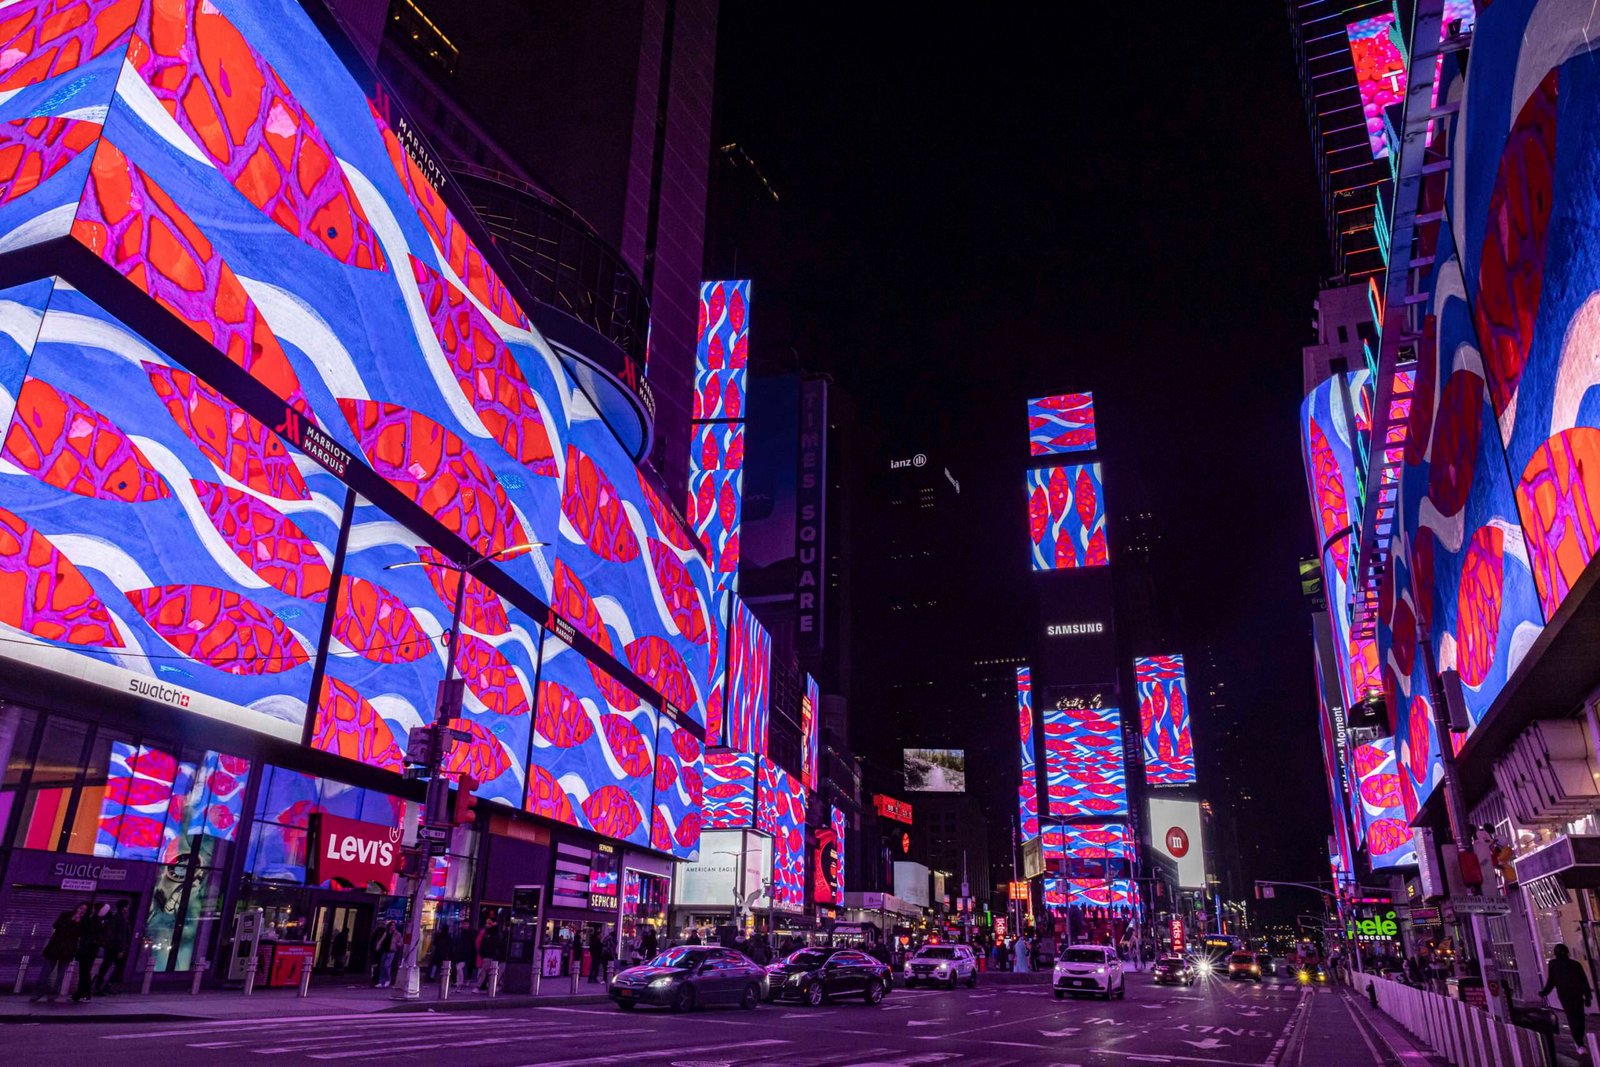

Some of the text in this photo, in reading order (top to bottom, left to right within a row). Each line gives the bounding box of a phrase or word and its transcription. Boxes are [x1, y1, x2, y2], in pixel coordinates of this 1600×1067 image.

[399, 117, 446, 187] MARRIOTT
[304, 439, 344, 474] MARQUIS
[306, 426, 351, 465] MARRIOTT
[799, 392, 818, 632] TIMES SQUARE
[1047, 623, 1103, 636] SAMSUNG
[129, 679, 182, 705] swatch
[1332, 707, 1346, 748] Moment
